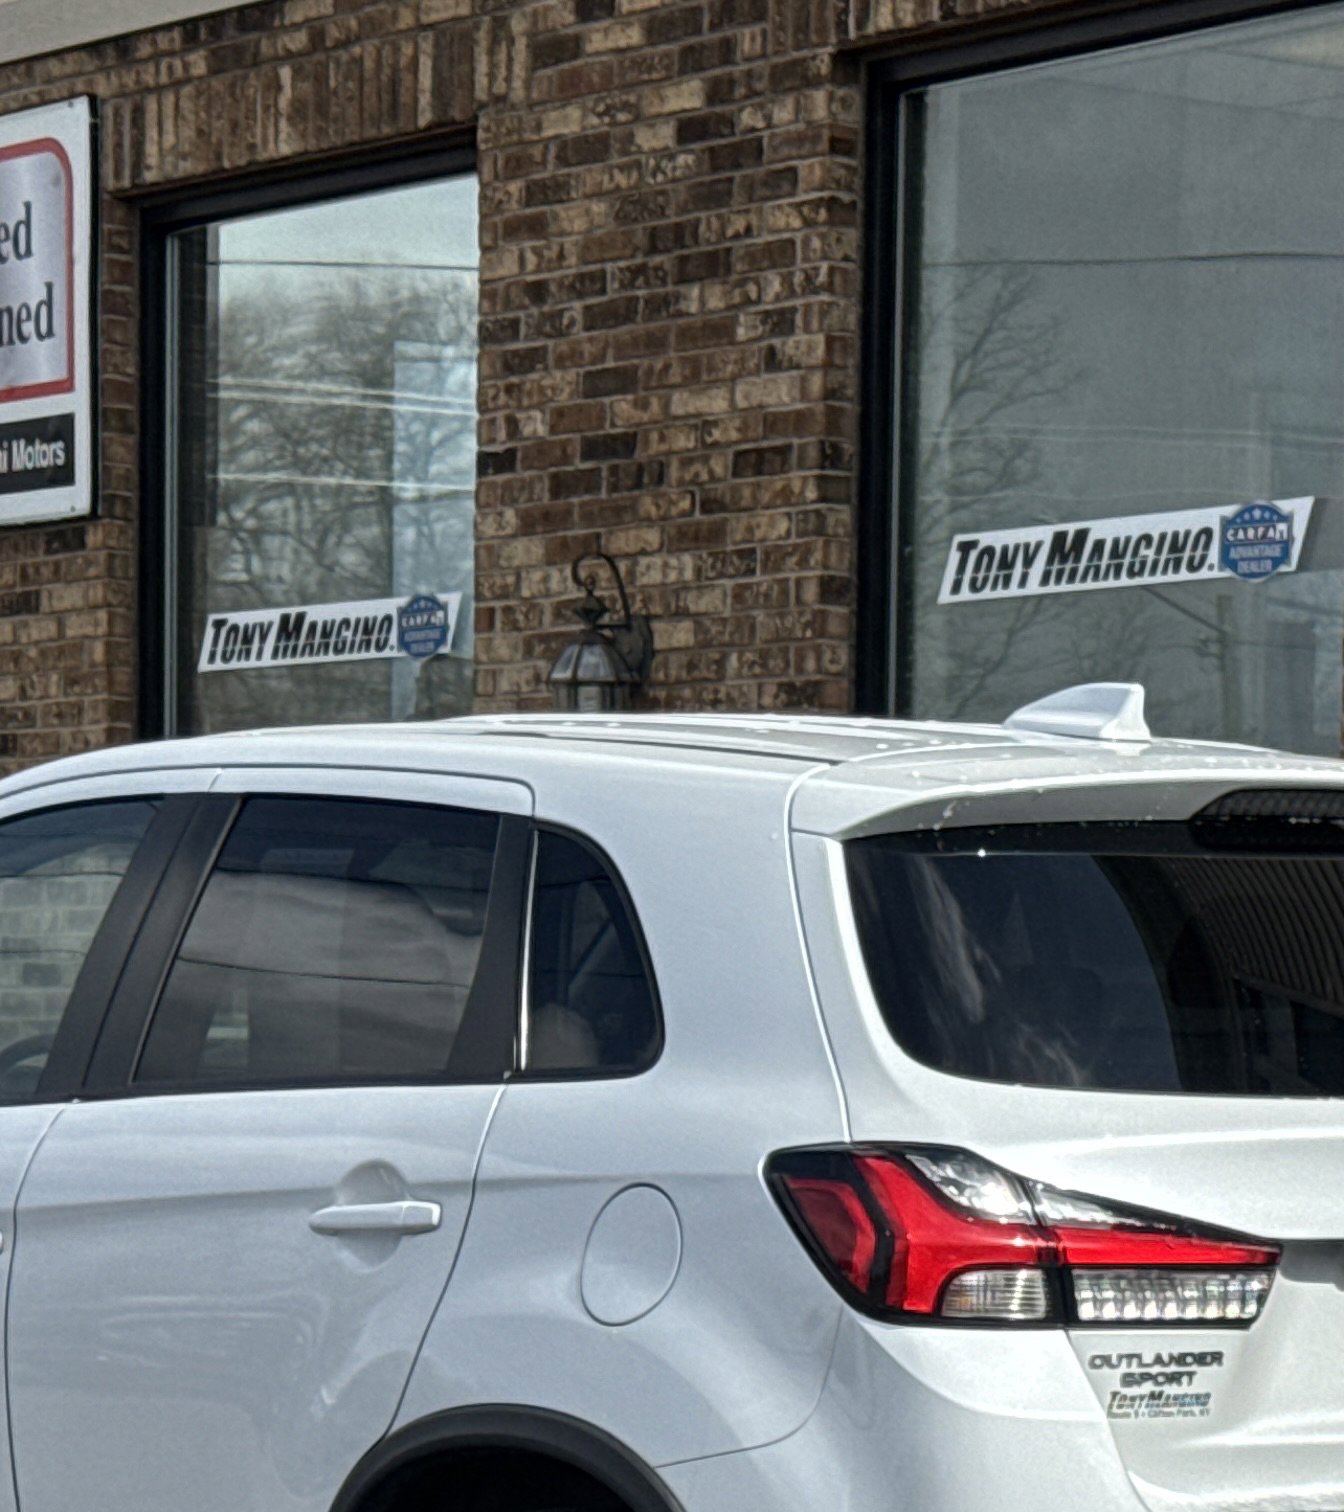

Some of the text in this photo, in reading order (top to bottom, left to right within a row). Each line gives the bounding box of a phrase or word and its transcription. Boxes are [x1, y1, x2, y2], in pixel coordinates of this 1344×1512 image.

[11, 437, 66, 473] Motors
[1088, 1349, 1224, 1369] OUTLANDER
[1119, 1370, 1197, 1388] SPORT
